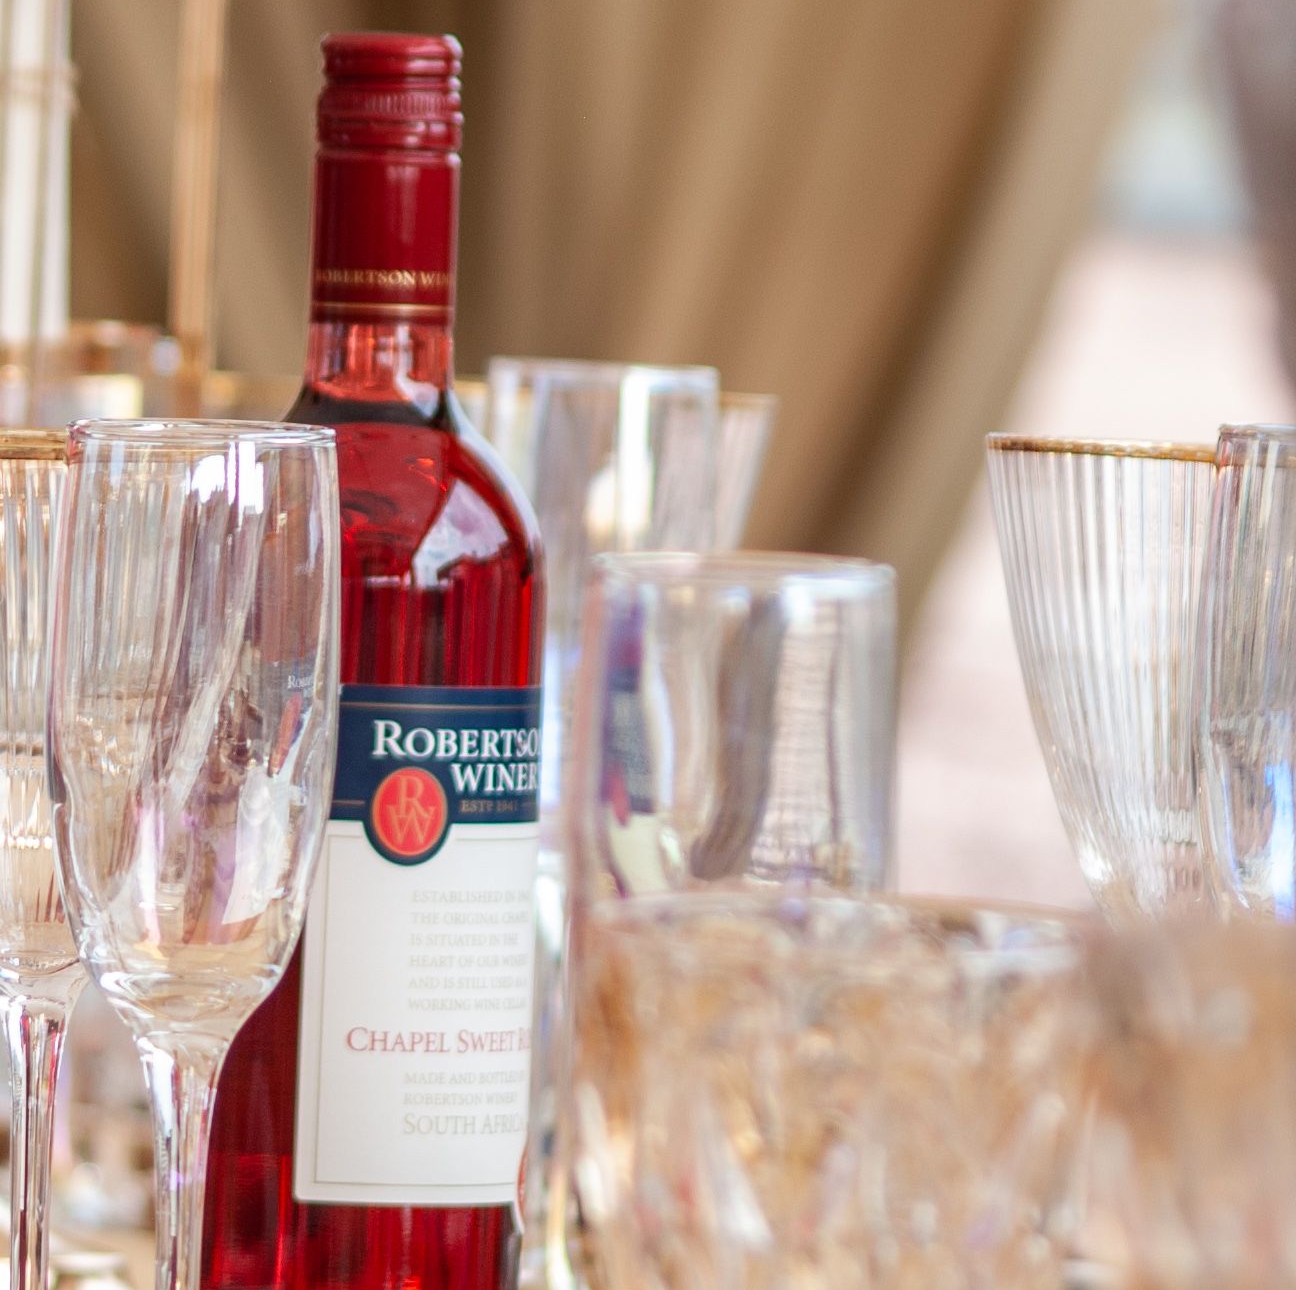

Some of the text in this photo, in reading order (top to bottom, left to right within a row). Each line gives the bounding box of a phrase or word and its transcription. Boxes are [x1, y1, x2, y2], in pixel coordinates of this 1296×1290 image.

[412, 890, 503, 903] ESTABLISHED
[410, 912, 440, 924] THE
[443, 912, 499, 924] ORIGINAL
[410, 933, 423, 946] IS
[425, 933, 486, 946] SITUATED
[409, 955, 456, 967] HEART
[458, 955, 474, 967] OF
[408, 977, 440, 989] AND
[408, 997, 472, 1010] WORKING
[346, 1026, 450, 1053] CHAPEL
[457, 1028, 515, 1053] SWEET
[404, 1071, 447, 1085] MADE
[448, 1071, 477, 1085] AND
[403, 1092, 483, 1106] ROBERTSON
[403, 1112, 476, 1136] SOUTH
